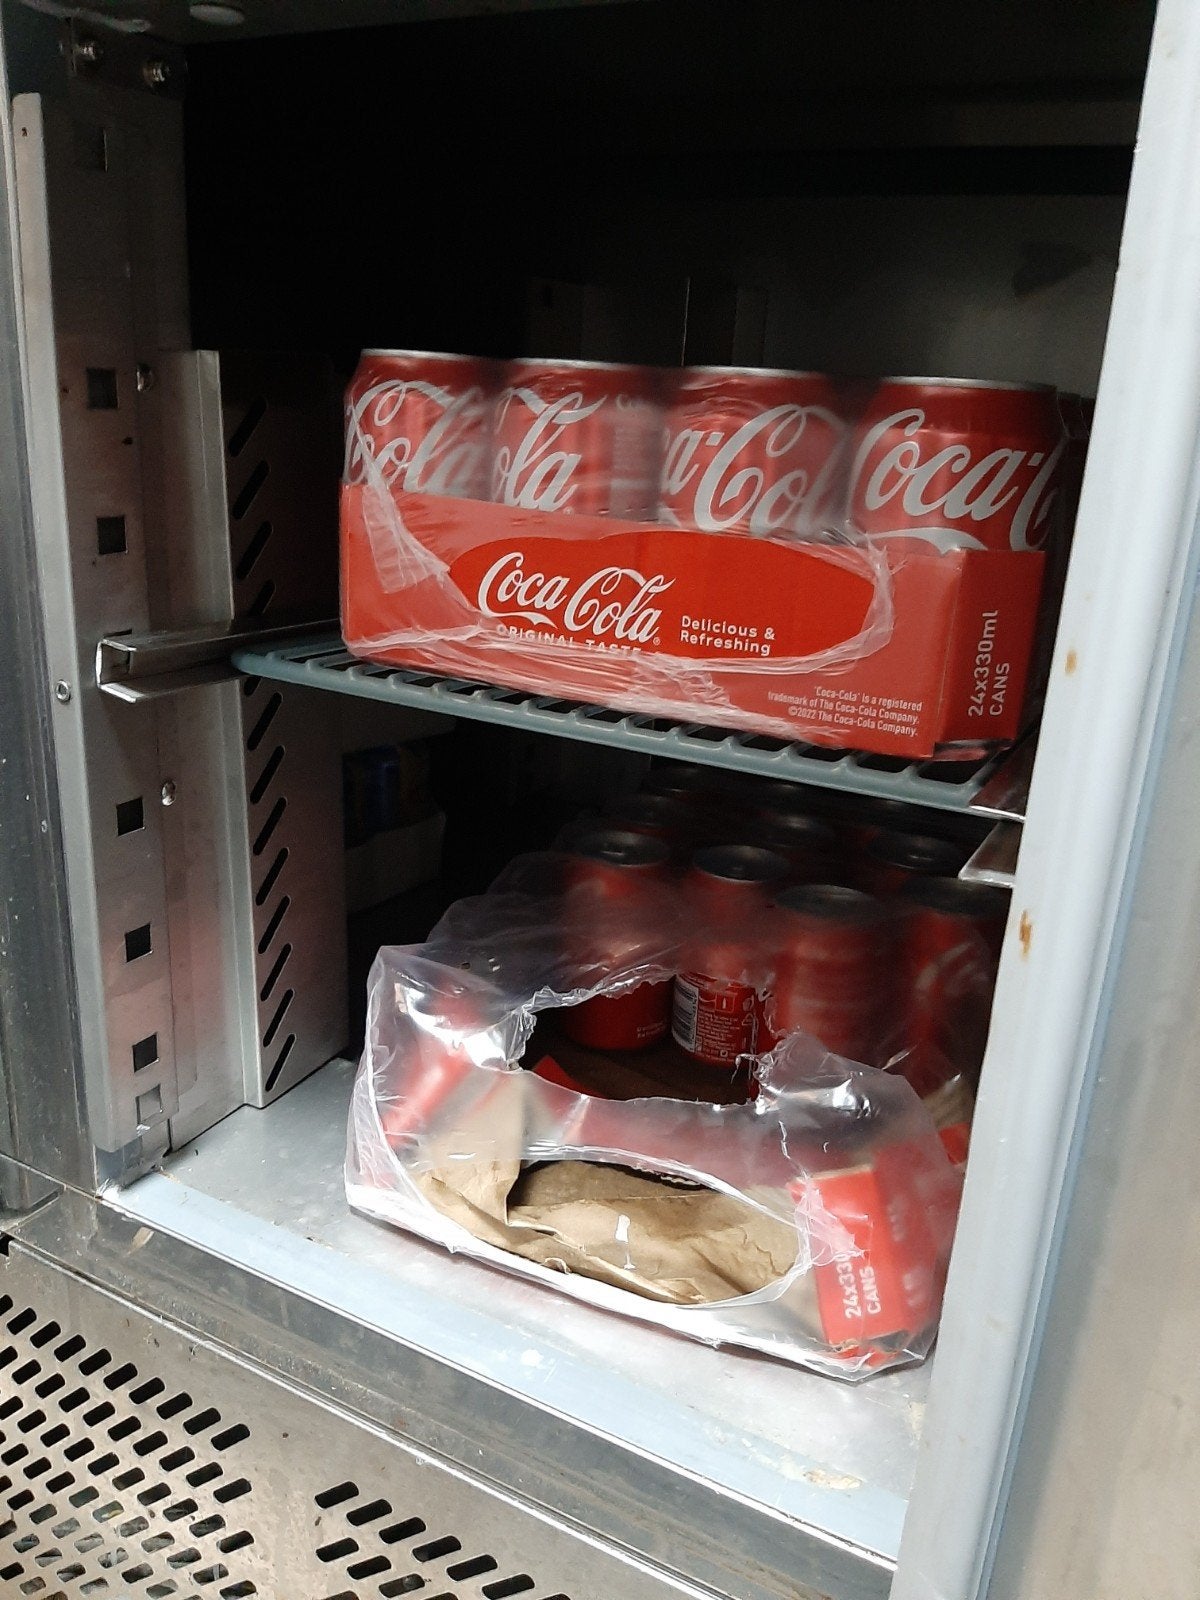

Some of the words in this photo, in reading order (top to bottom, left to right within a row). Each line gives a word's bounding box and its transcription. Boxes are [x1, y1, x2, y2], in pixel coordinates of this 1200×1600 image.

[496, 624, 575, 647] ORIGINAL
[680, 615, 758, 638] Delicious
[764, 627, 776, 640] &
[680, 630, 771, 656] Refreshing
[968, 609, 998, 717] 24x330ml
[862, 693, 870, 703] is
[872, 696, 877, 705] a
[879, 697, 923, 711] registered
[989, 662, 1010, 716] CANS
[768, 691, 808, 706] trademark
[809, 698, 818, 708] of
[819, 698, 834, 711] The
[835, 701, 877, 717] Coca-Cola
[818, 710, 833, 723] The
[834, 713, 876, 729] Coca-Cola
[877, 720, 919, 737] Company.
[859, 1266, 882, 1315] CANS
